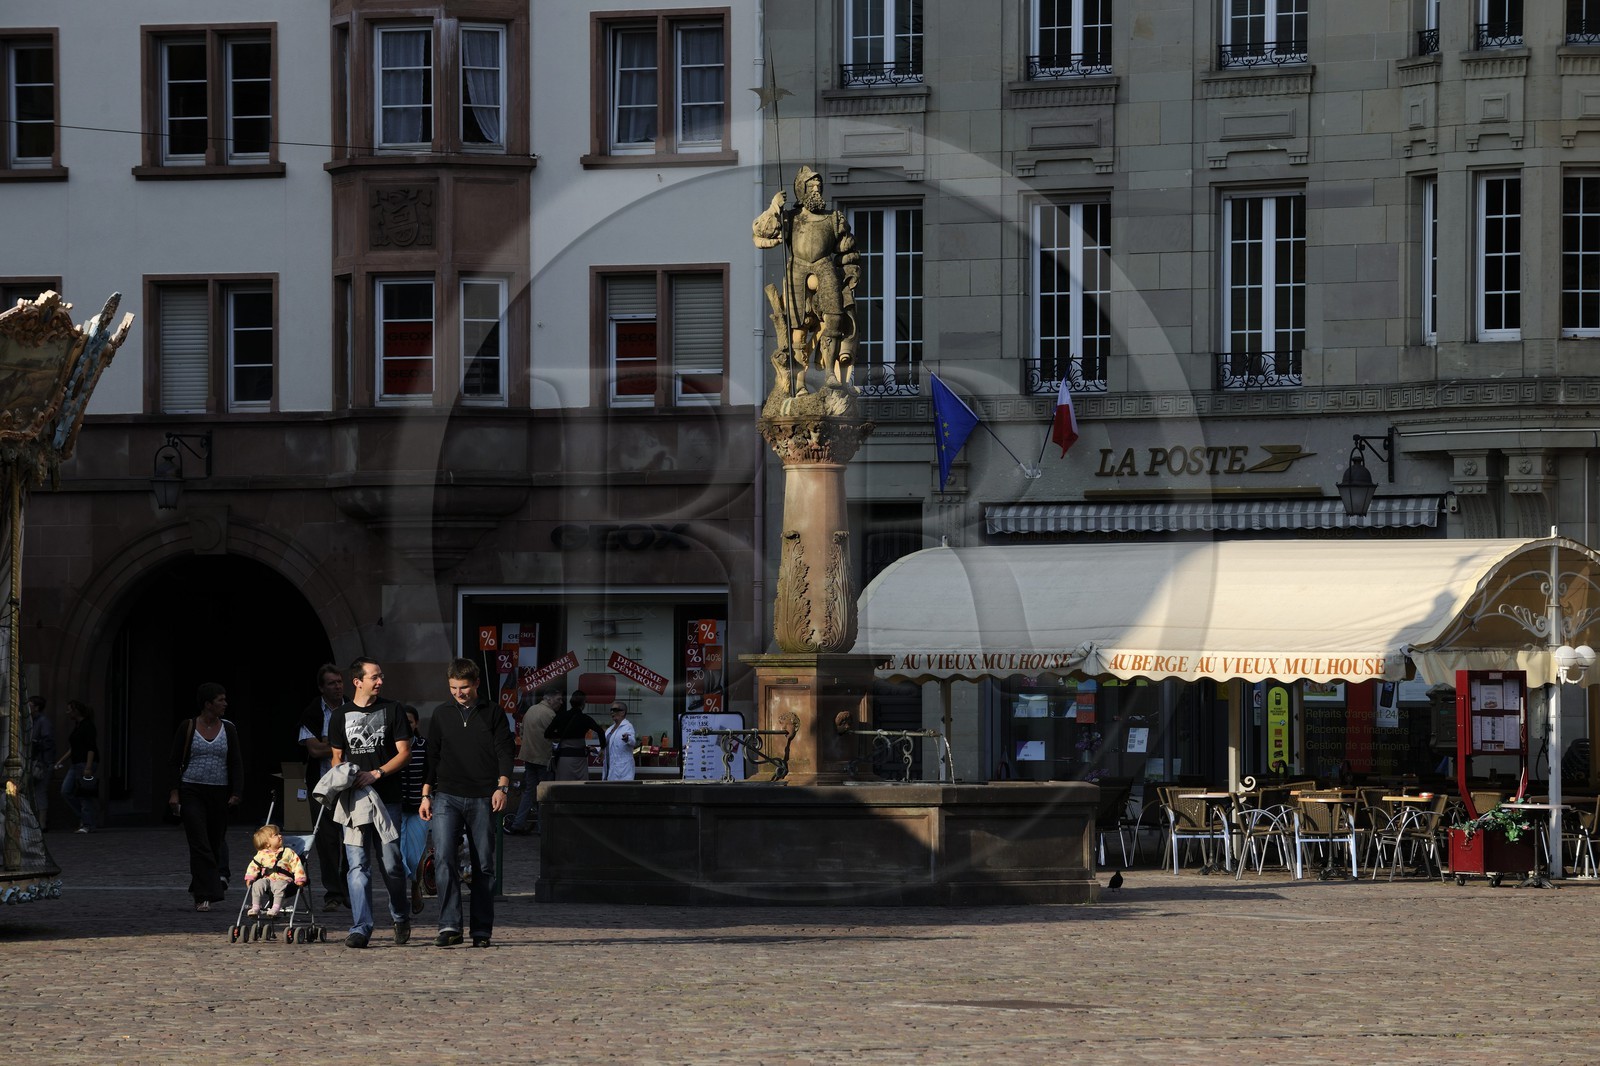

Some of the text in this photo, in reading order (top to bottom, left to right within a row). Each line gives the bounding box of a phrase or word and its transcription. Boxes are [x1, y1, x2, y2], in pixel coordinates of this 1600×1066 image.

[388, 331, 431, 341] GEOX
[1095, 445, 1248, 476] LA POSTE
[550, 523, 690, 551] GEOX
[706, 653, 721, 662] 40%
[901, 654, 922, 670] AU
[927, 653, 977, 670] VIEUX
[981, 653, 1072, 670] MULHOUSE
[617, 655, 663, 684] DEUXIÈME
[1109, 653, 1386, 676] AUBERGE AU VIEUX MULHOUSE
[1306, 708, 1342, 719] Retraits
[1306, 724, 1410, 735] Placements financiers
[1306, 740, 1410, 752] Gestion de patrimoine
[1347, 757, 1399, 767] mmobiliers
